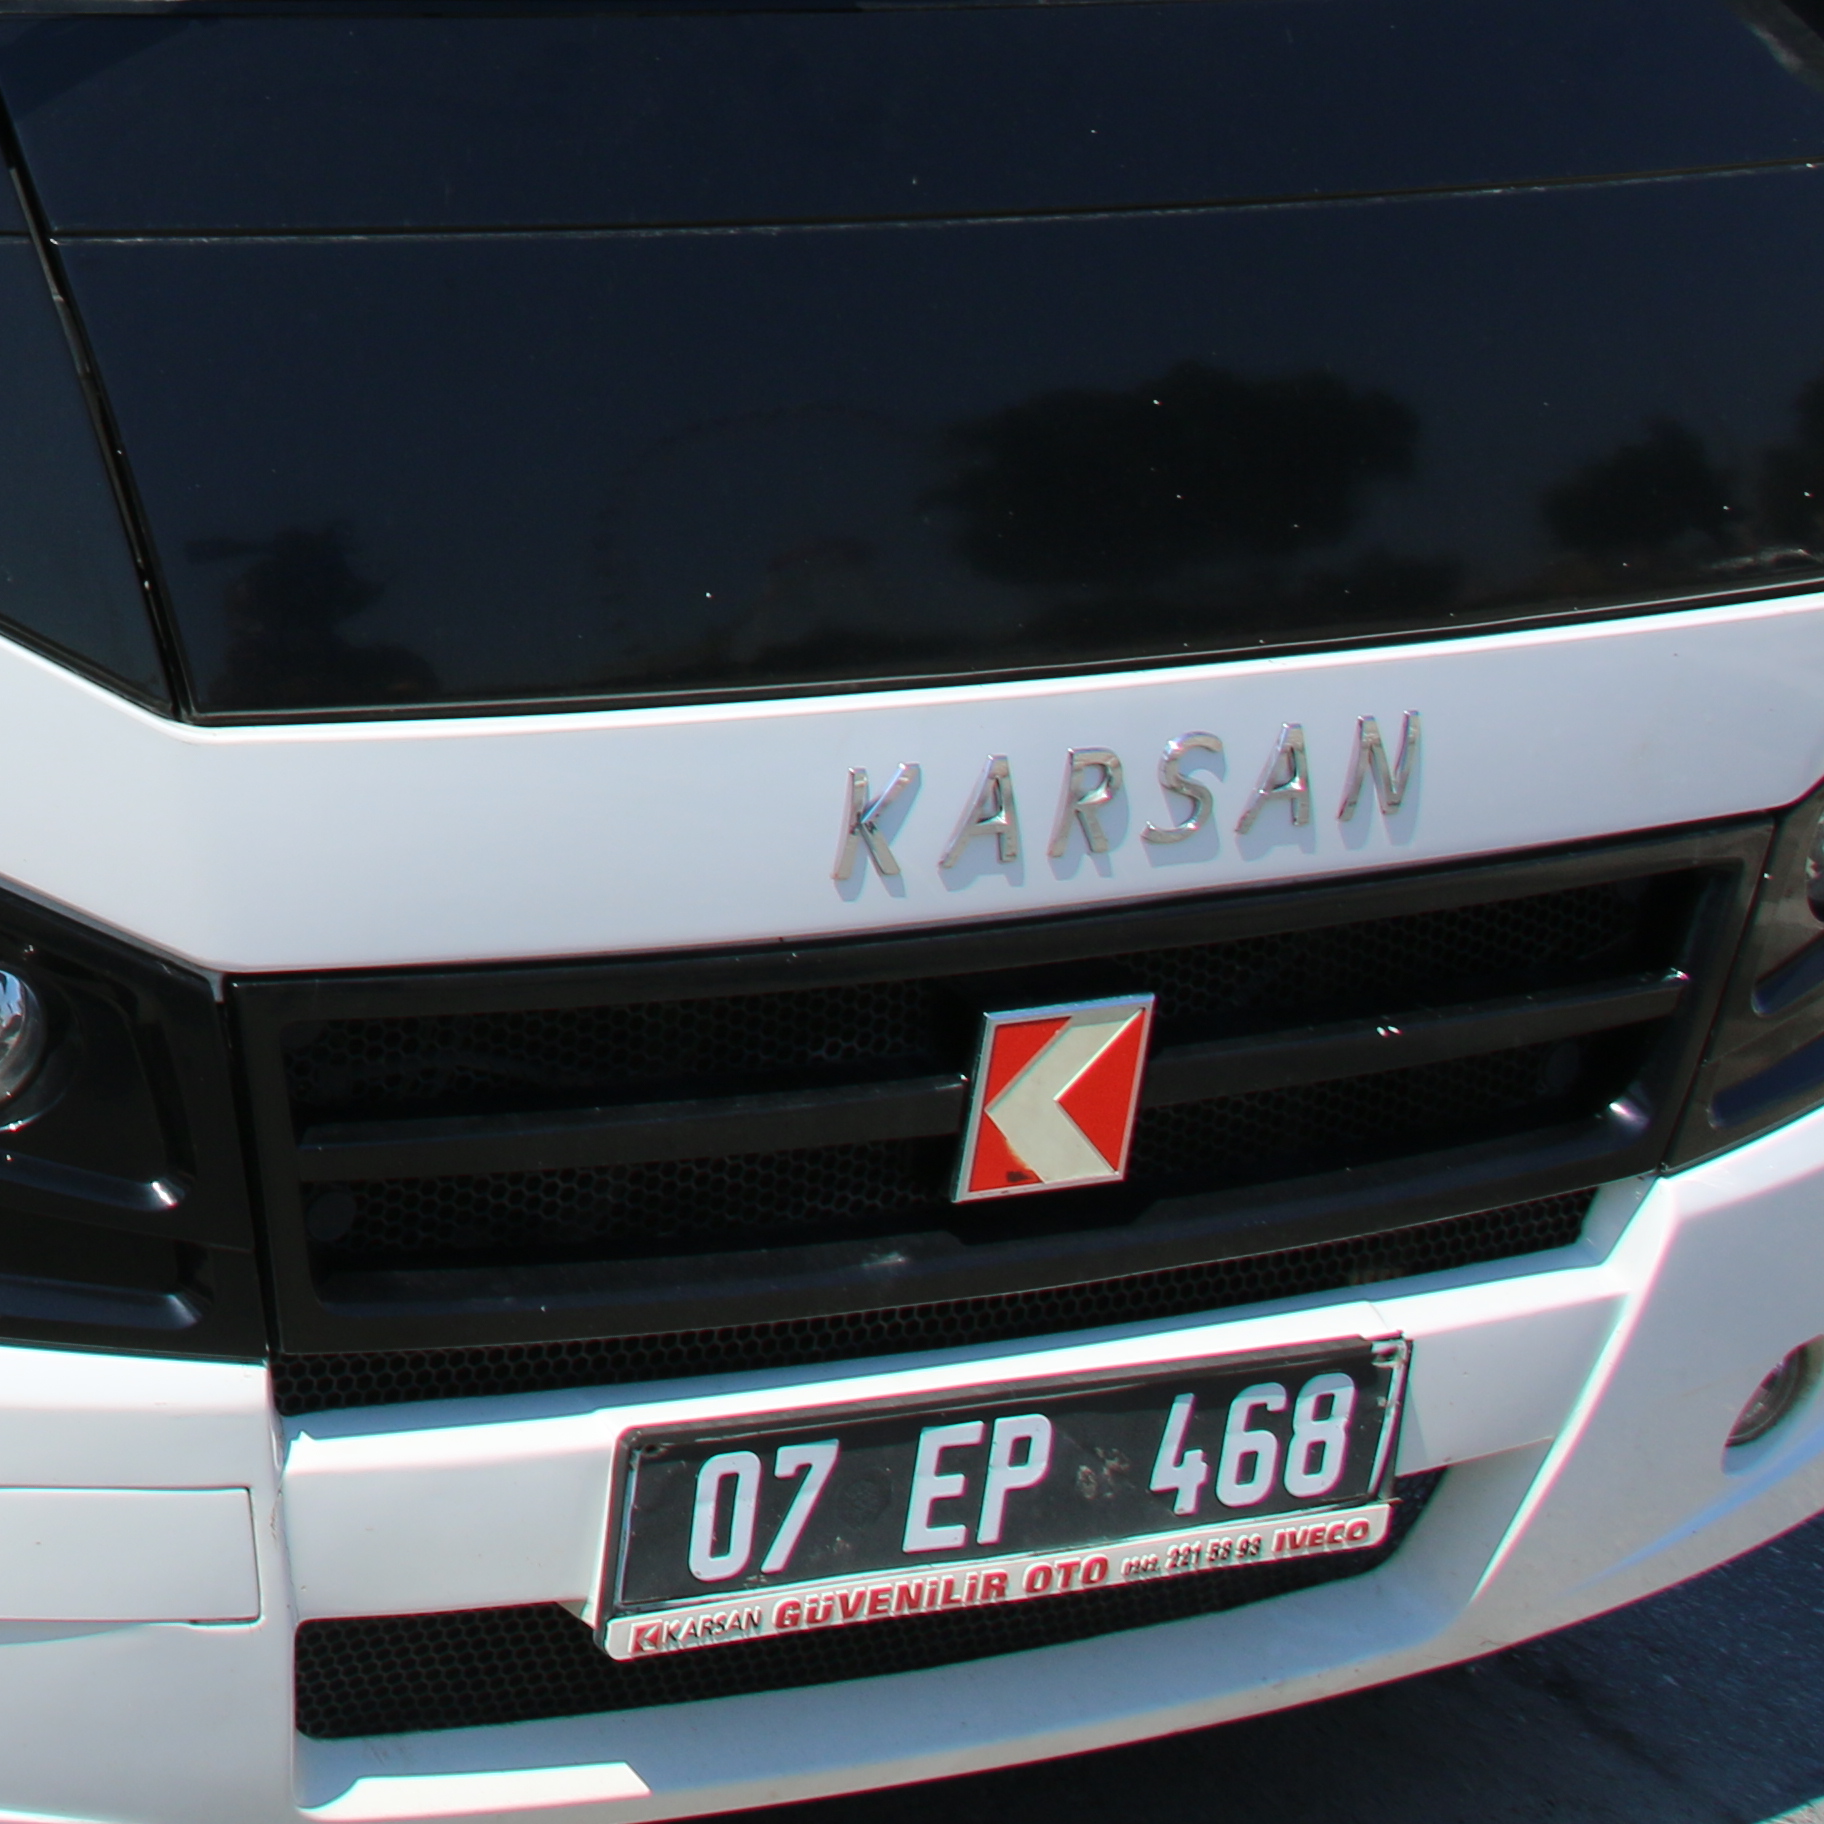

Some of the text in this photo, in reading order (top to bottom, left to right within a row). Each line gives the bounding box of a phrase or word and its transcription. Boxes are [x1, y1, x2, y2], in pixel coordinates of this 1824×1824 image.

[830, 709, 1420, 881] KARSAN
[687, 1372, 1355, 1582] 07 EP 468
[662, 1606, 762, 1646] KARSAN
[1024, 1554, 1109, 1594] OTO
[1272, 1518, 1370, 1554] IVECO
